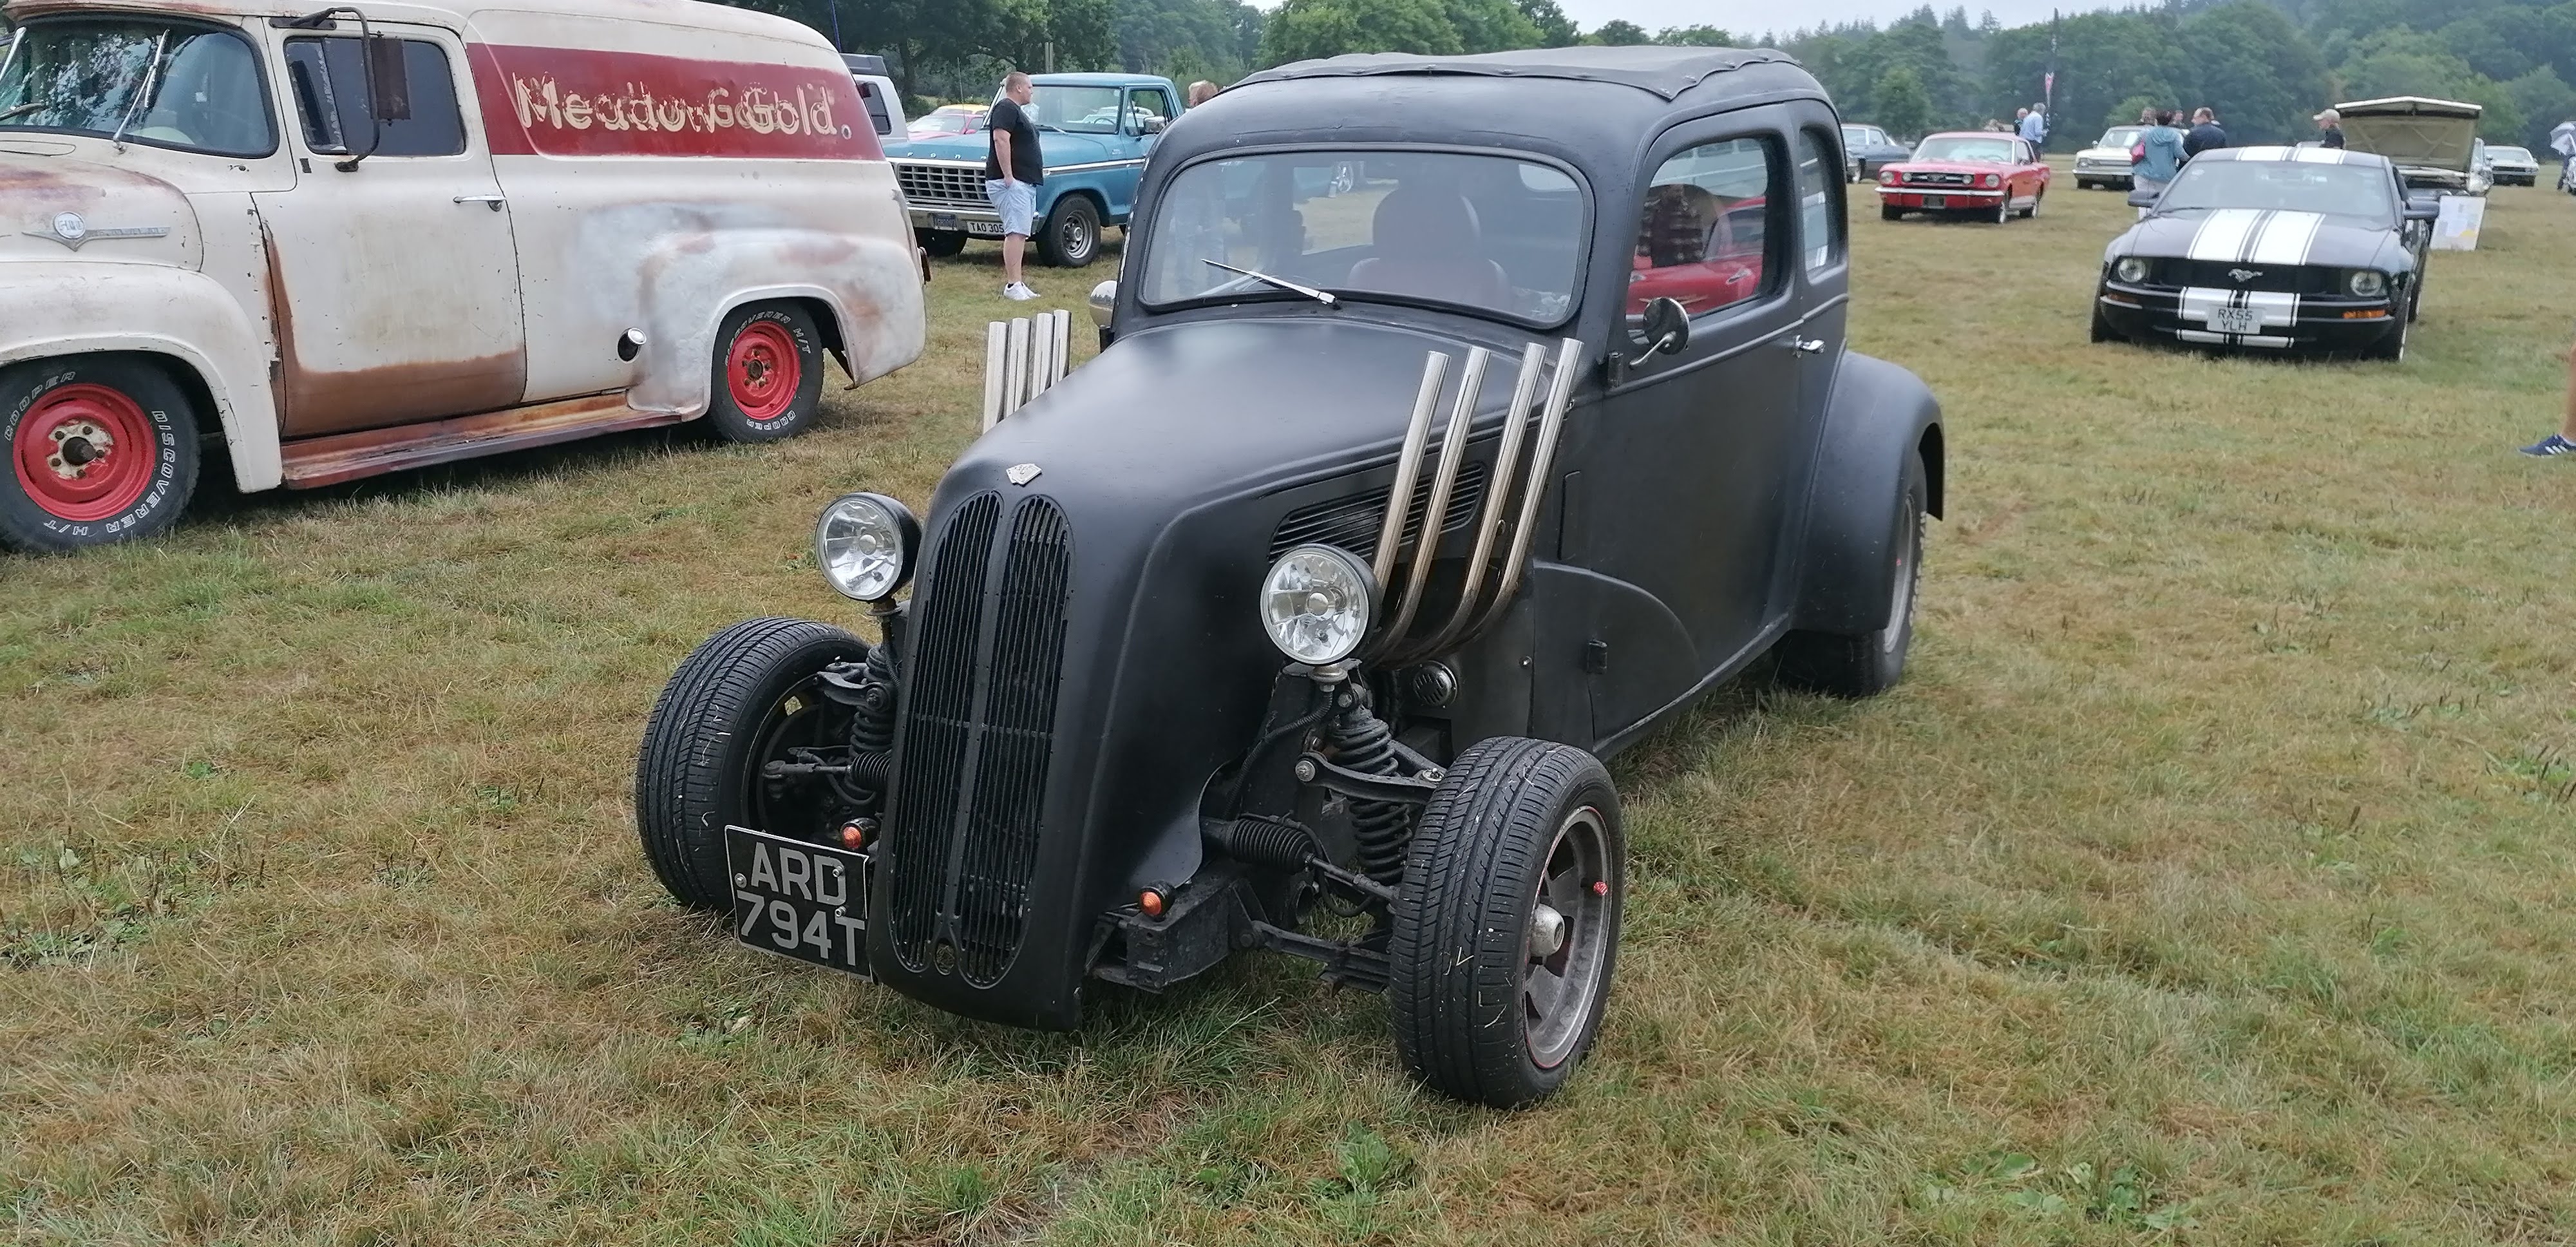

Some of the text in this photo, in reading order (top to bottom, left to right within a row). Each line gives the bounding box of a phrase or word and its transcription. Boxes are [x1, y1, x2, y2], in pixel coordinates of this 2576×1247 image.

[793, 328, 811, 354] H/T
[2218, 309, 2253, 321] RX55
[2222, 319, 2247, 331] YLH
[5, 371, 76, 441] COOPER
[44, 410, 175, 536] DISCOVERER H/T
[751, 841, 847, 906] ARD
[737, 890, 866, 966] 794T
